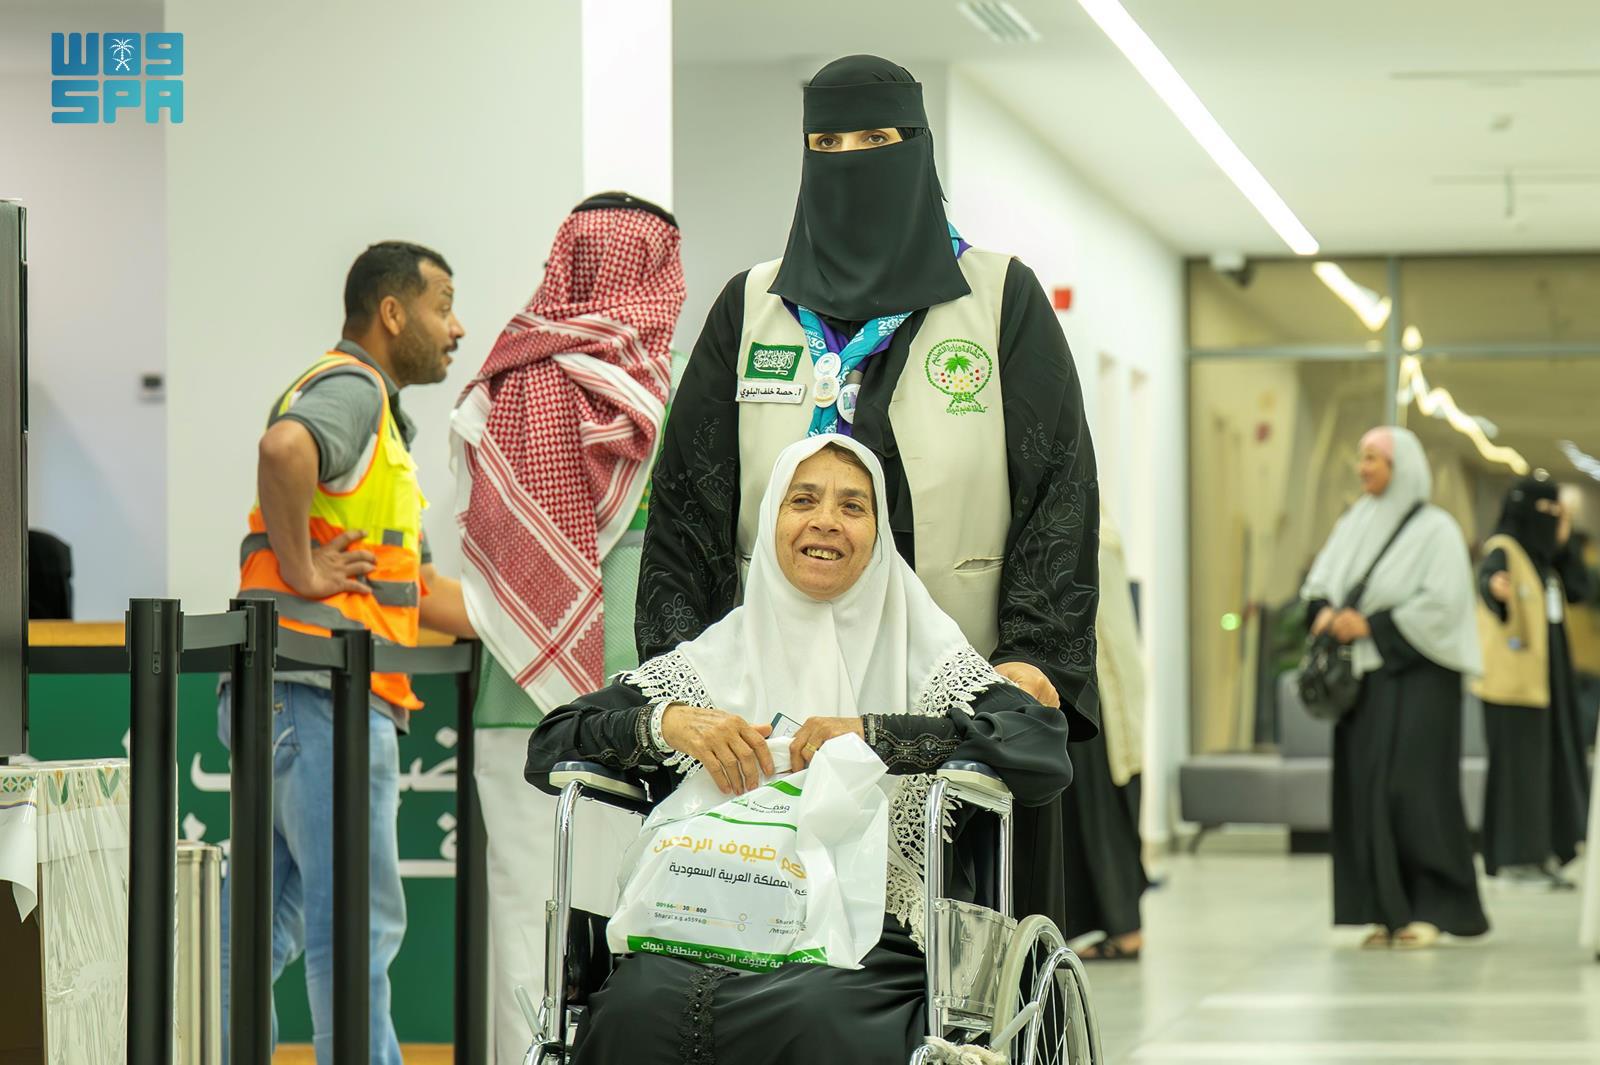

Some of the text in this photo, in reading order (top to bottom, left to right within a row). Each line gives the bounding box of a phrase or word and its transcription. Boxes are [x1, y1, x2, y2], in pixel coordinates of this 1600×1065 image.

[740, 387, 760, 398] البلوي
[760, 387, 775, 396] خلف
[775, 387, 793, 396] حصة
[654, 835, 713, 853] الرحمن
[719, 839, 777, 862] ضيوف
[669, 861, 716, 878] السعودية
[718, 868, 751, 885] العربية
[753, 873, 793, 889] المملكة
[640, 941, 664, 953] تبوك
[666, 943, 703, 958] بمنطقة
[704, 950, 737, 963] الرحمن
[739, 954, 768, 968] ضيوف
